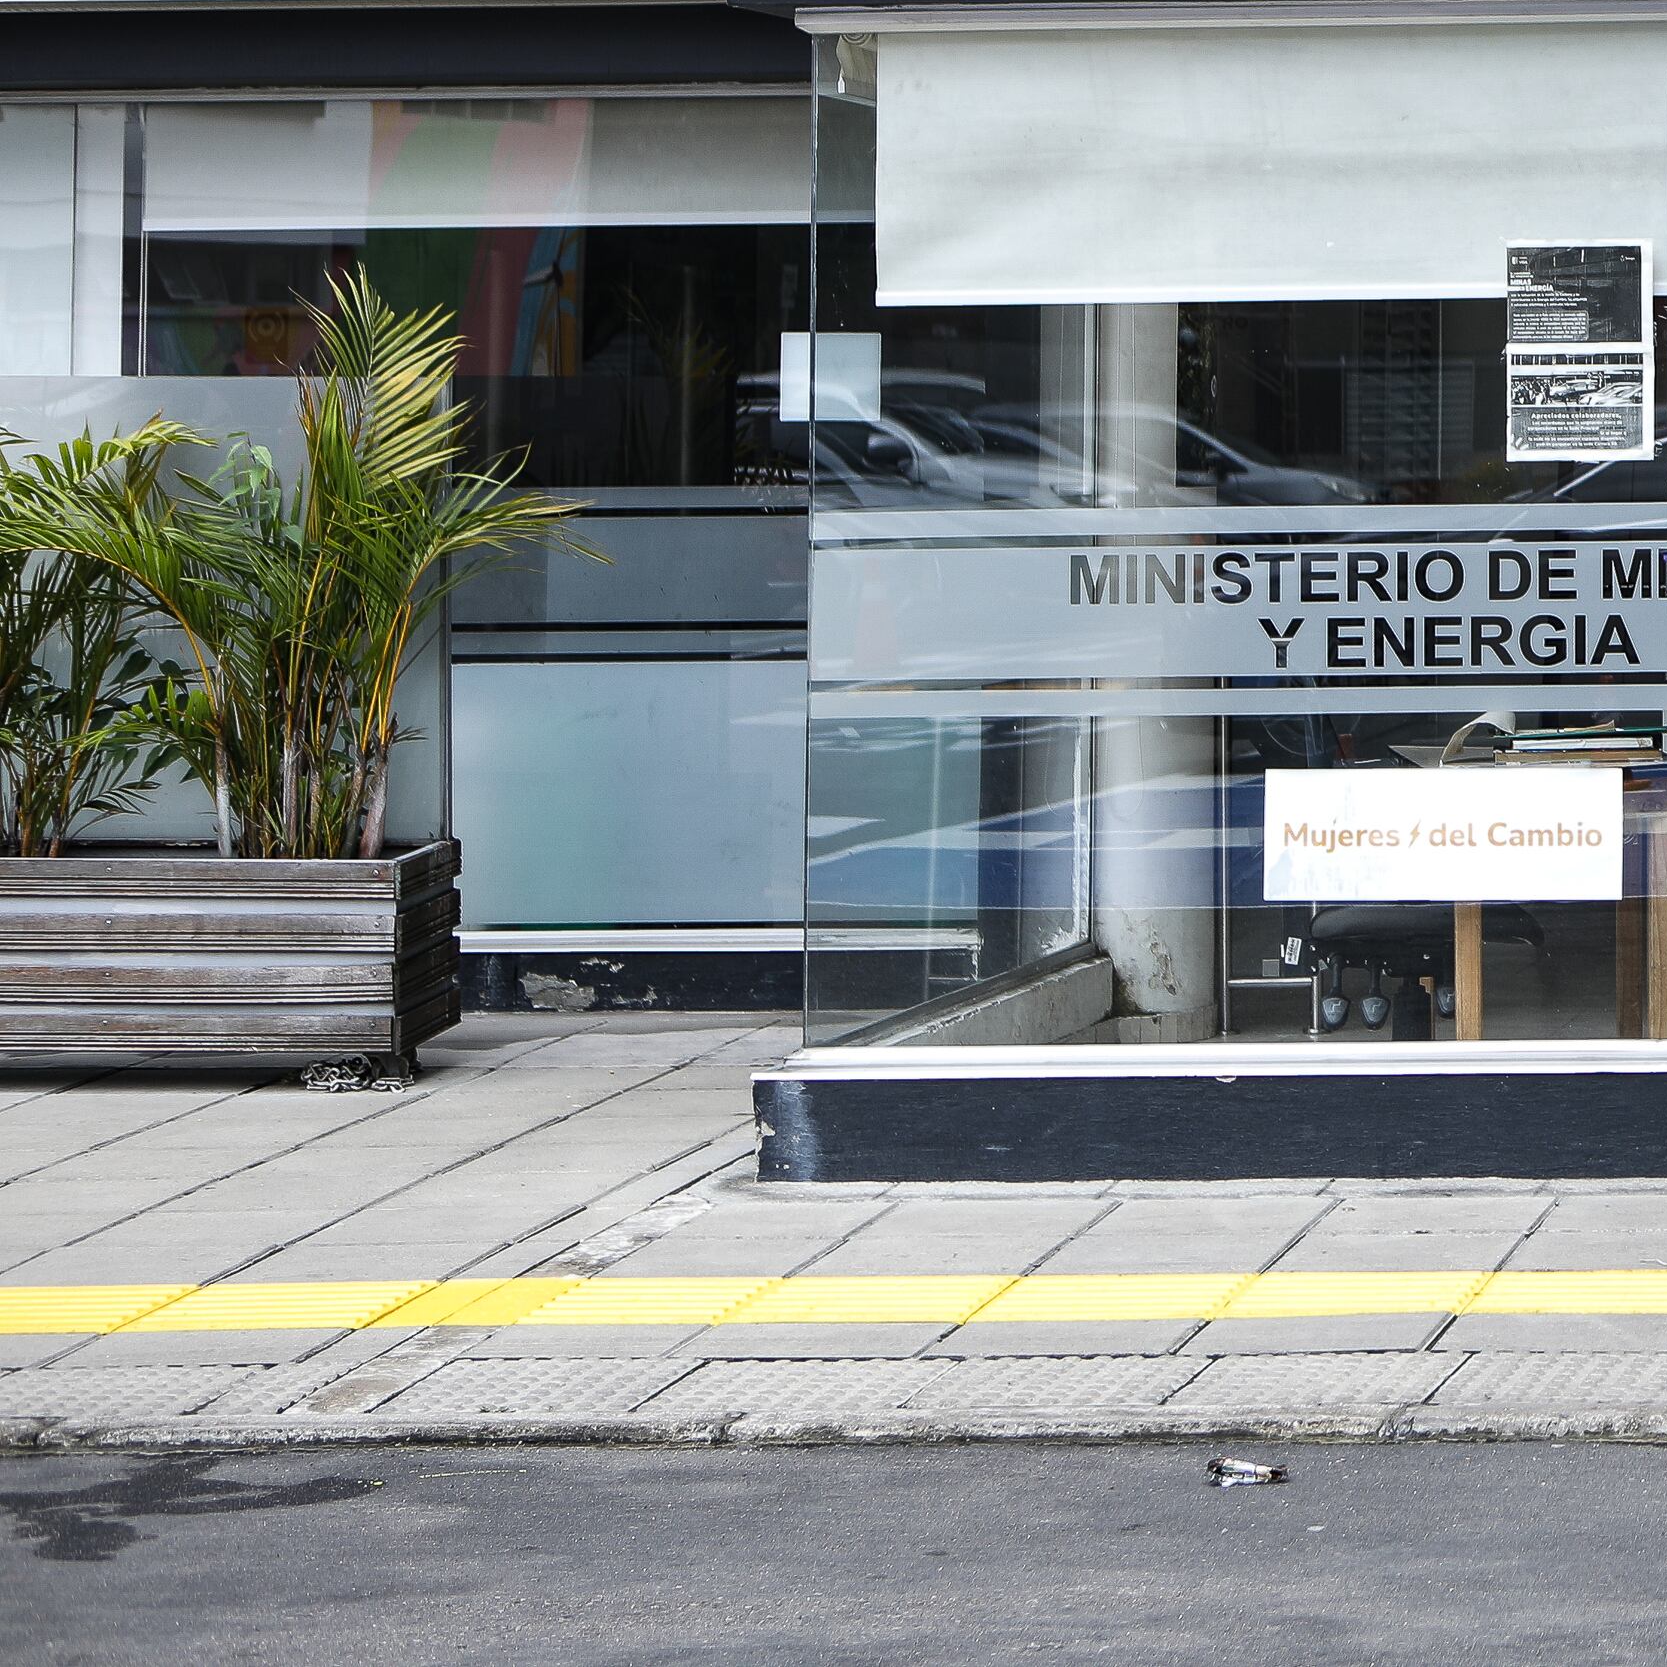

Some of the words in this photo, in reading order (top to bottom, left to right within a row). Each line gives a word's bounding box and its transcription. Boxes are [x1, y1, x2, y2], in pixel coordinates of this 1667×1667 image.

[1069, 549, 1465, 605] MINISTERIO
[1488, 549, 1578, 601] DE
[1257, 617, 1305, 669] Y
[1327, 614, 1641, 669] ENERGIA
[1283, 821, 1400, 854] Mujeres
[1429, 823, 1477, 847] del
[1487, 821, 1602, 847] Cambio
